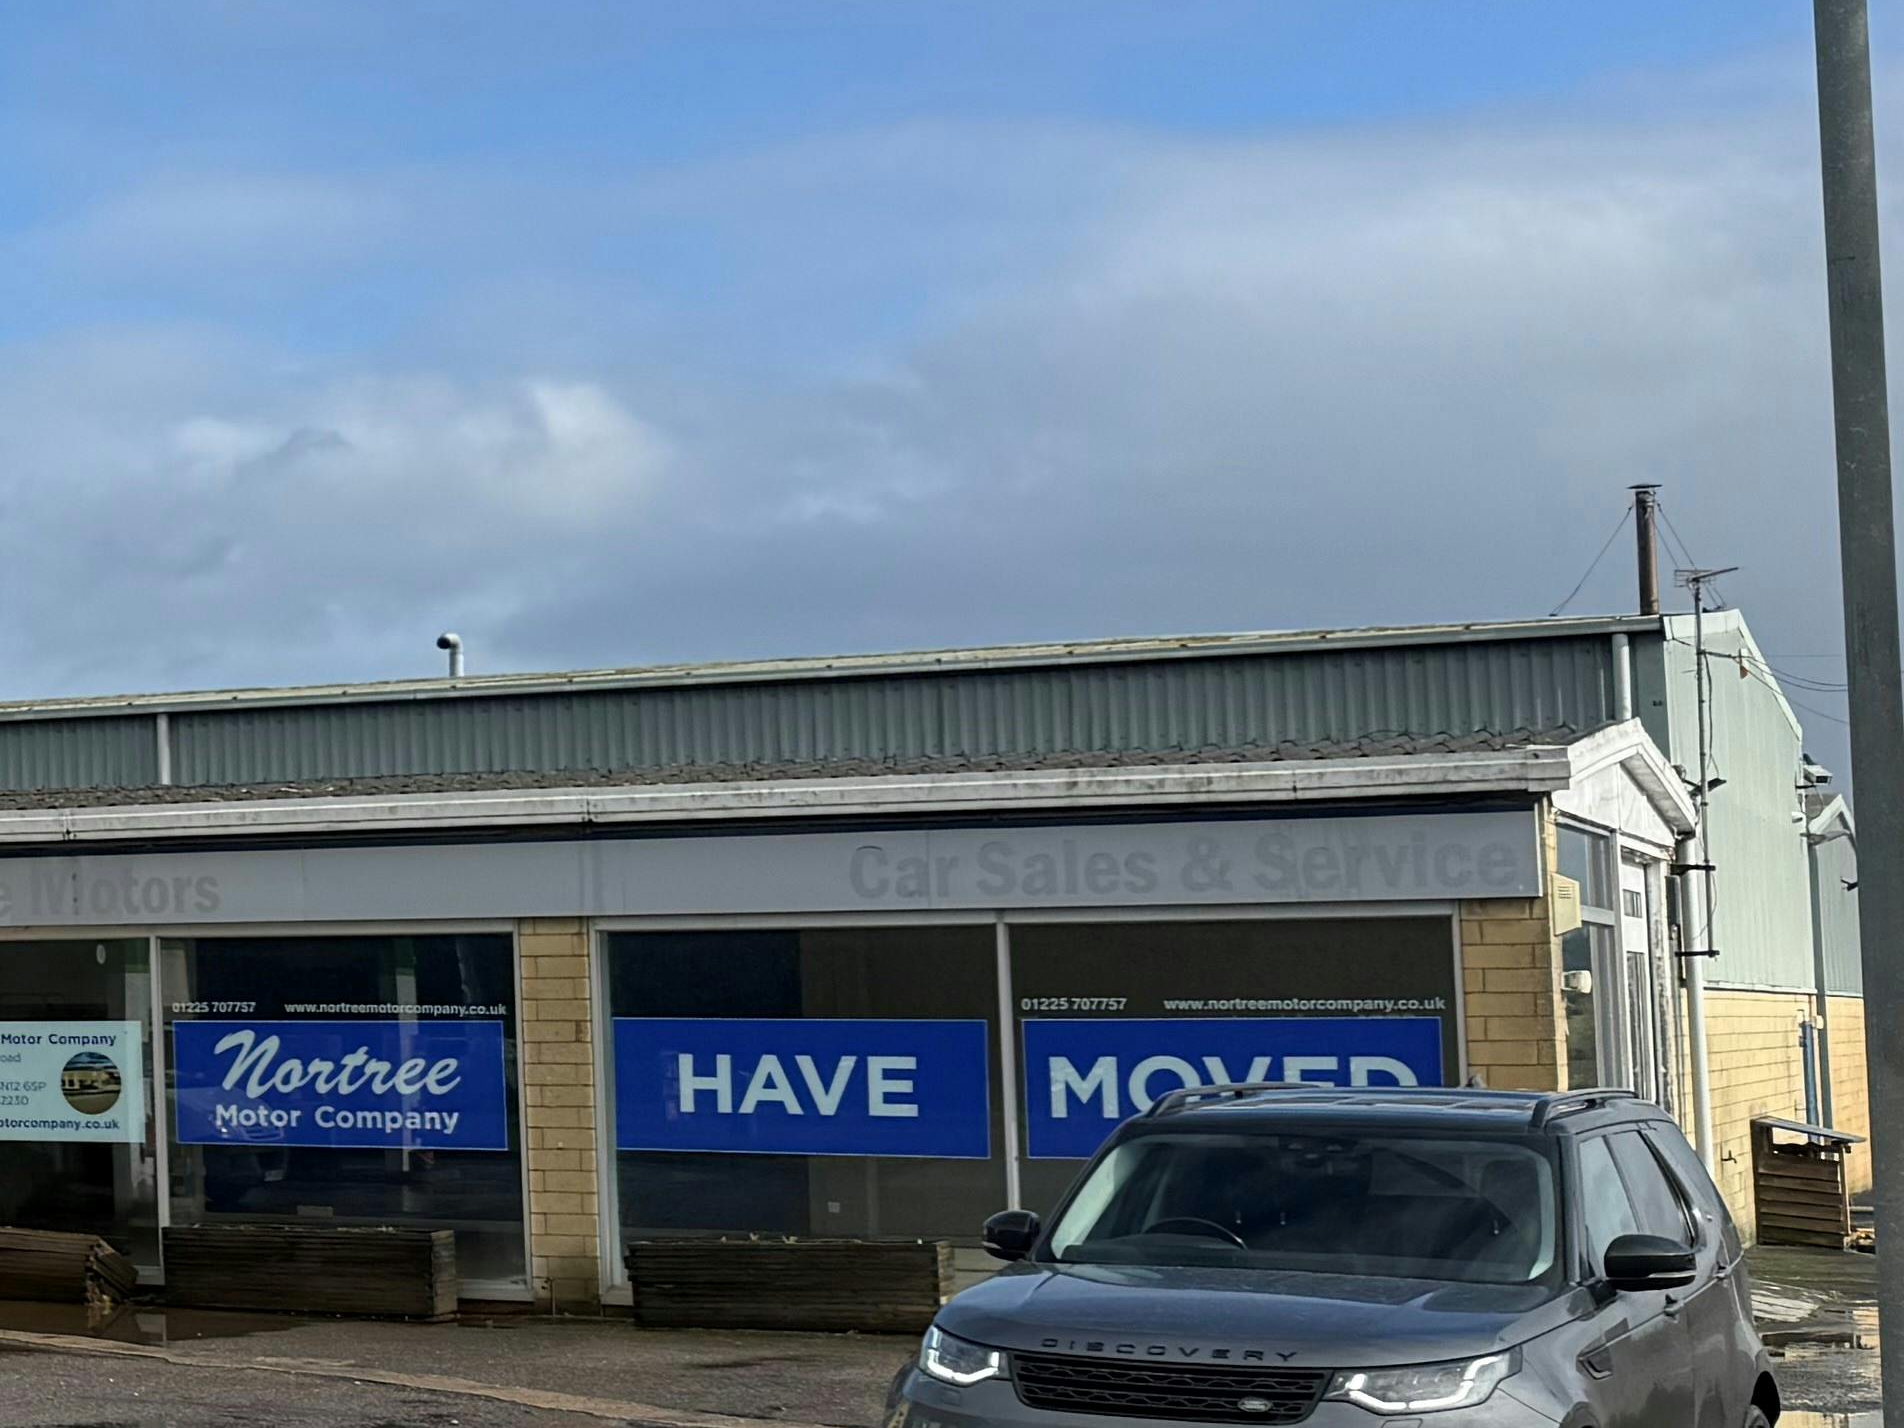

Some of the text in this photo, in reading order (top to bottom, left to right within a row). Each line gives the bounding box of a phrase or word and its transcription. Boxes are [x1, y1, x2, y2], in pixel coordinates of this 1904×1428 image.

[849, 832, 1515, 899] Car Sales & Service
[31, 867, 221, 917] Motors
[284, 1002, 507, 1017] www.nortreemotorcompany.co.uk
[1021, 996, 1446, 1013] 01225 707757 www.nortreemotorcompany.co.uk
[0, 1033, 42, 1045] Motor
[48, 1033, 117, 1047] Company
[213, 1028, 462, 1099] Nortree
[677, 1052, 919, 1117] HAVE
[215, 1104, 460, 1134] Motor Company
[1041, 1337, 1298, 1362] DISCOVERY
